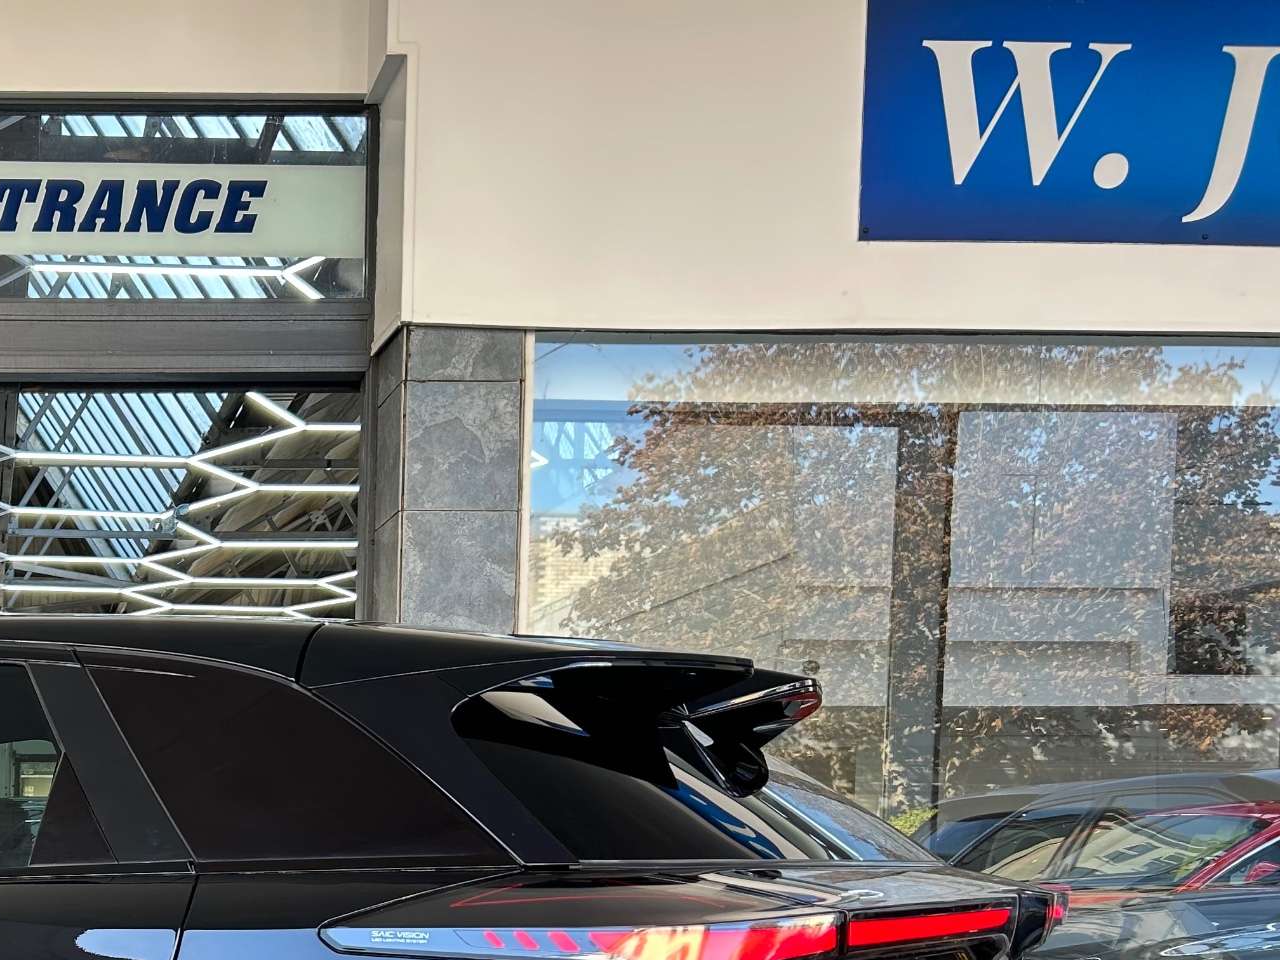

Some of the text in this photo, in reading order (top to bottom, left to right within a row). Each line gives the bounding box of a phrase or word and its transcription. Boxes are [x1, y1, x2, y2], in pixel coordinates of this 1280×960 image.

[922, 39, 1280, 223] W. J
[371, 930, 429, 939] SAIC VISION
